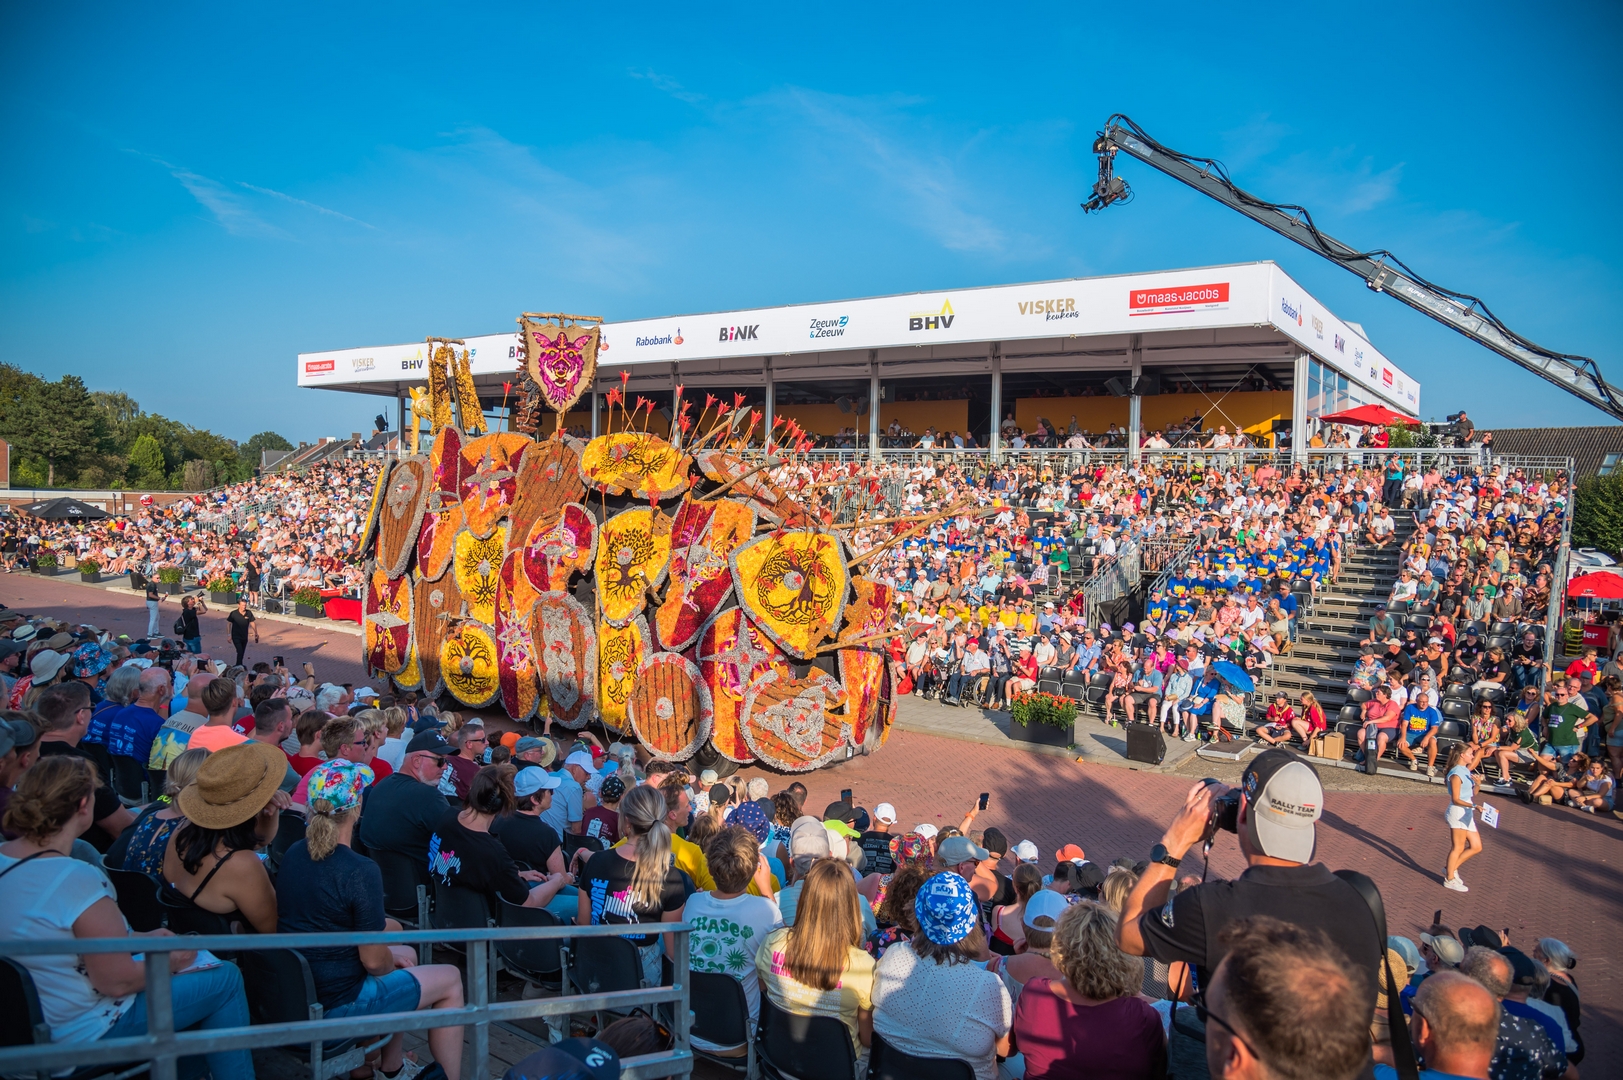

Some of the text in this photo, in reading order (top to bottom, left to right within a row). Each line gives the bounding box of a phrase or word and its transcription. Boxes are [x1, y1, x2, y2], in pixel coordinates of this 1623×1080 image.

[1018, 298, 1076, 315] VISKER
[1046, 310, 1080, 321] keukens
[810, 318, 839, 329] Zeeuw
[909, 315, 955, 331] BHV
[635, 334, 672, 347] Rabobank
[401, 359, 424, 370] BHV
[1271, 798, 1315, 813] RALLY TEAM
